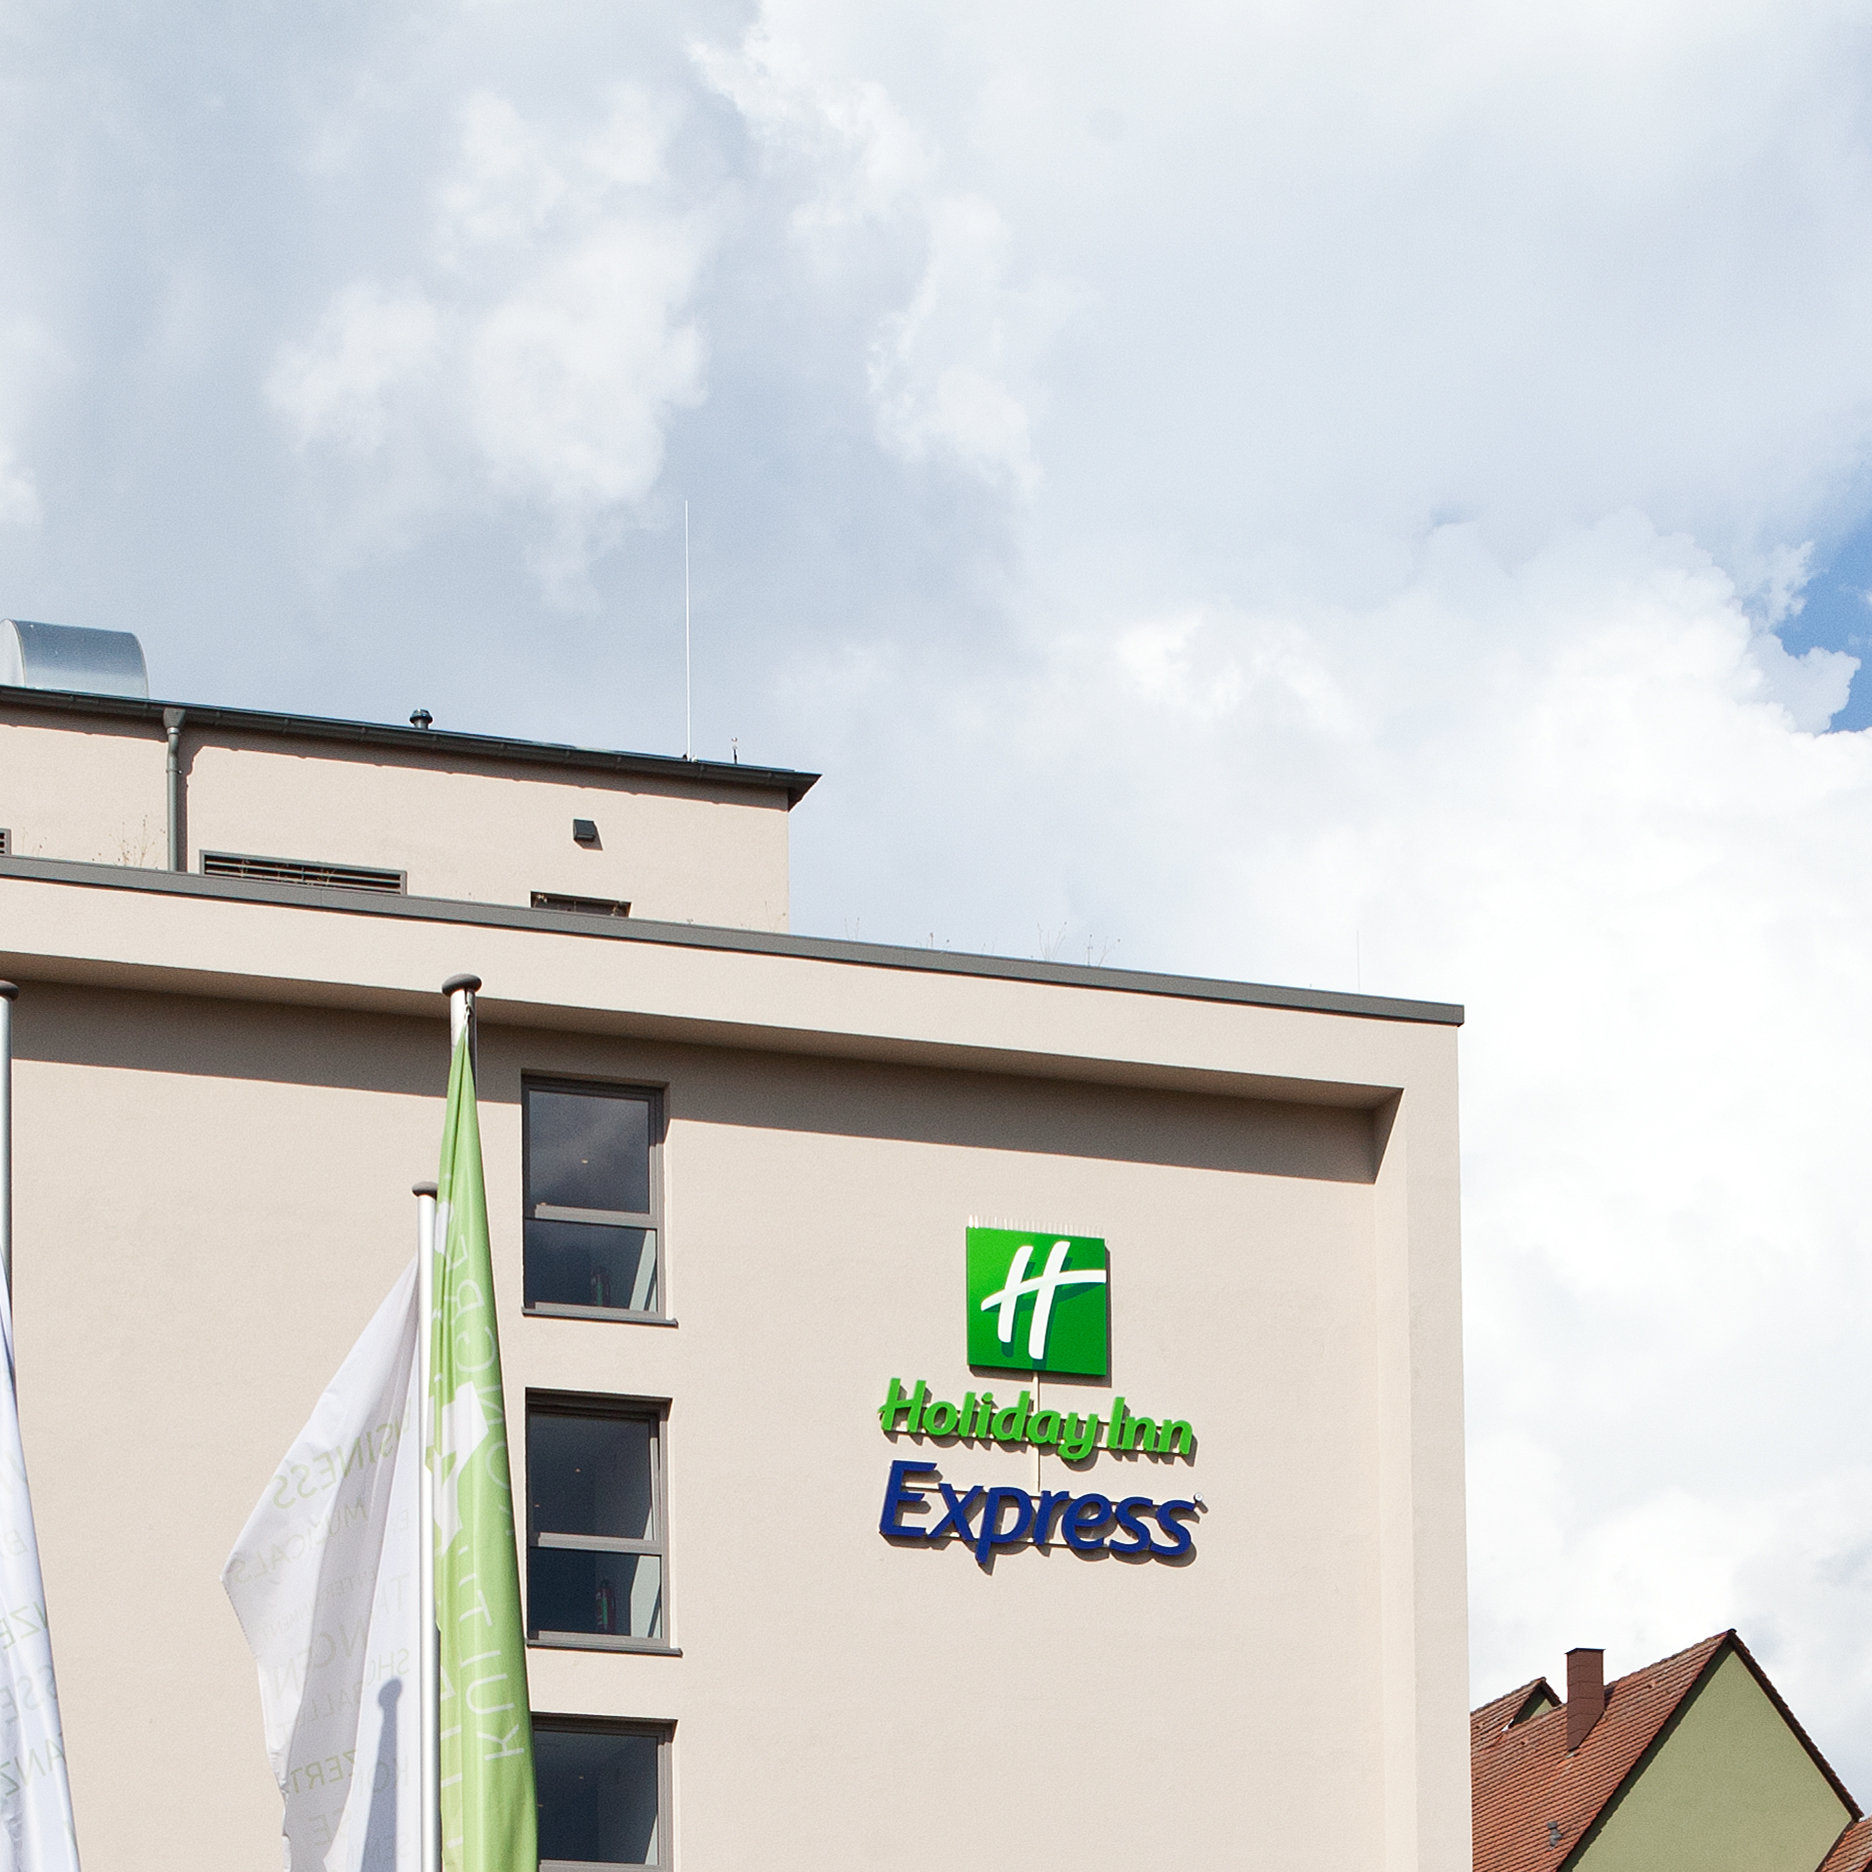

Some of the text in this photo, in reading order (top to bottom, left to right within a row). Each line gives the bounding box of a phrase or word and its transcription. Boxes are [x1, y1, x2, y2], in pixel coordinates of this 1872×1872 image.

[878, 1378, 1193, 1460] Holiday Inn
[879, 1460, 1196, 1564] Express
